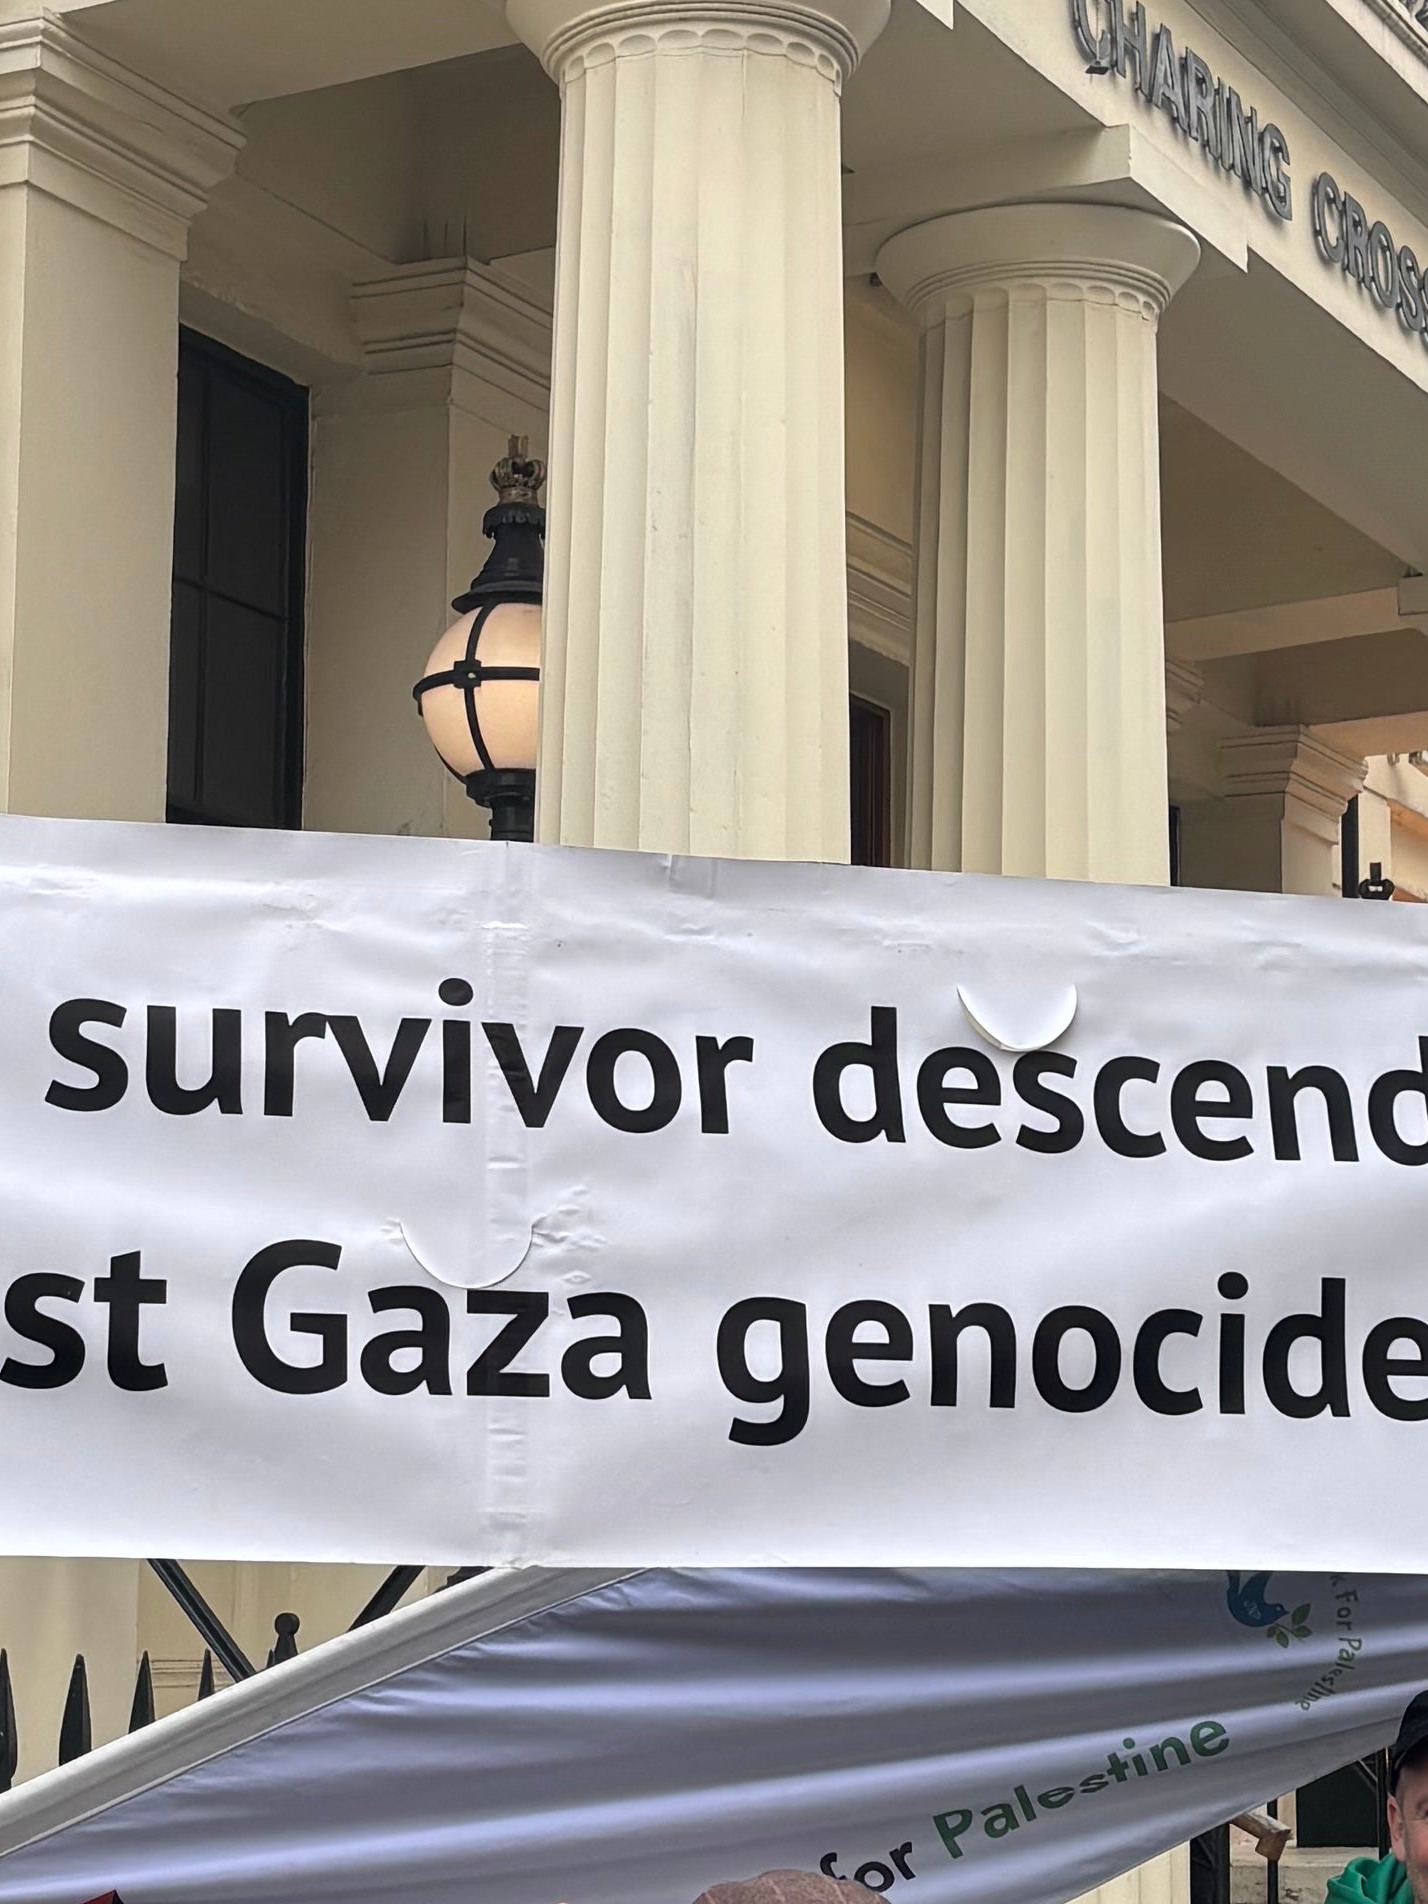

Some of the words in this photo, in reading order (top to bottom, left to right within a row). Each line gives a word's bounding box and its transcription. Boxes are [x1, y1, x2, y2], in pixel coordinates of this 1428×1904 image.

[45, 977, 753, 1135] survivor
[232, 1239, 652, 1400] Gaza
[1335, 1590, 1359, 1632] For
[933, 1720, 1231, 1860] Palestine
